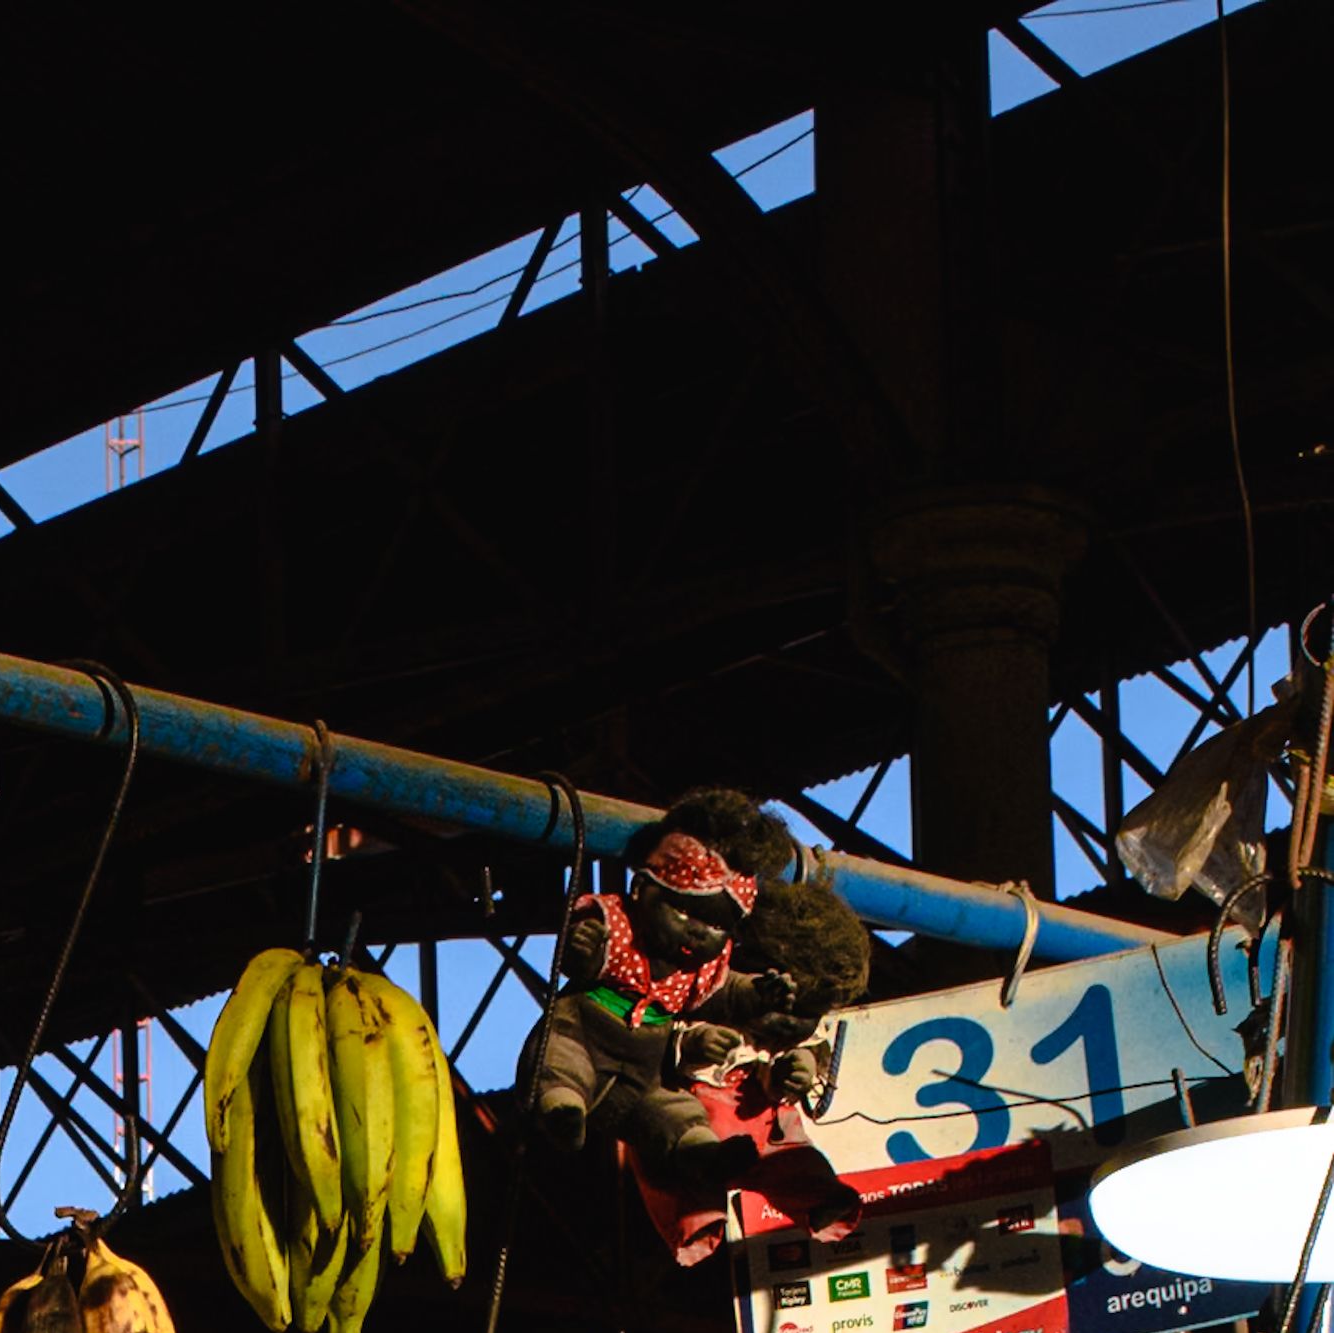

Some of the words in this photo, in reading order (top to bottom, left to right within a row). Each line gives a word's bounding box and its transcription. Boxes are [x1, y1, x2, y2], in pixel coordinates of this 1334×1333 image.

[881, 983, 1127, 1164] 31
[835, 1277, 862, 1291] CMR
[1106, 1277, 1213, 1314] arequipa
[949, 1299, 989, 1313] DISCOVER
